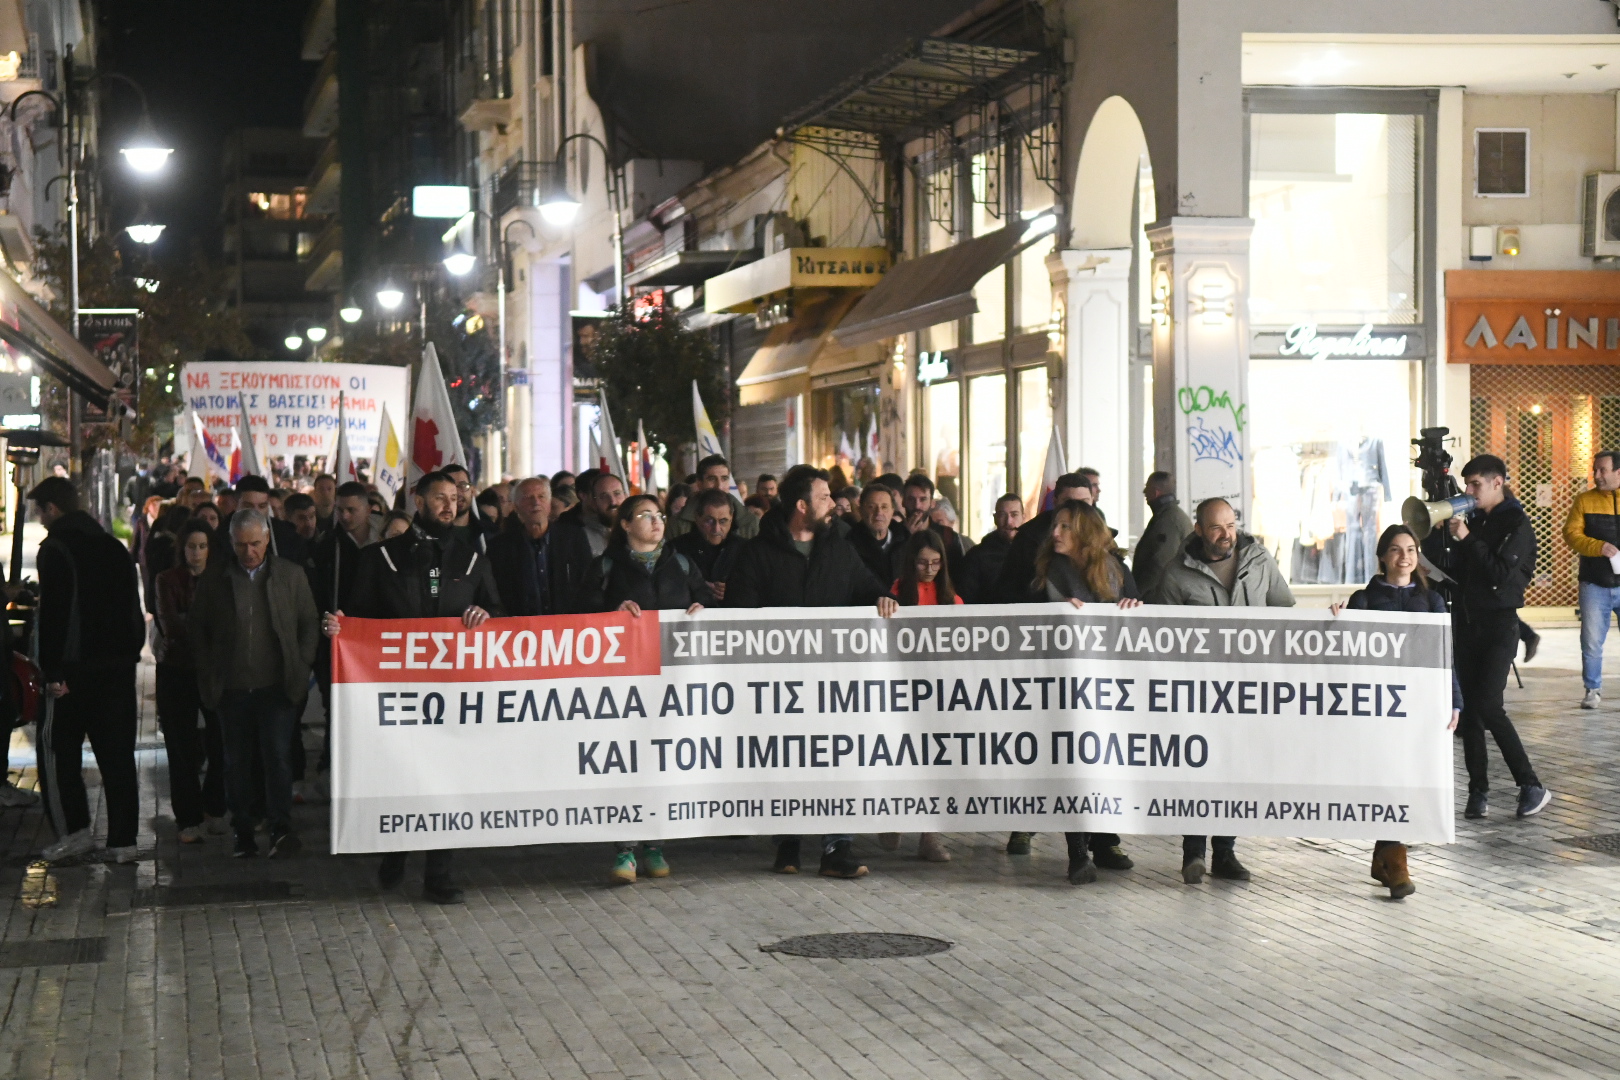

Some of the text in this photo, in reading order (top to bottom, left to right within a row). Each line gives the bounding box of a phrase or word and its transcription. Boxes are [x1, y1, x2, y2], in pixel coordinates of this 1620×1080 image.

[187, 371, 366, 390] ΝΑ ΞΕΚΟΥΜΠΙΣΤΟΥΝ ΟΙ
[190, 393, 259, 410] ΝΑΤΟΙΚΣ
[269, 394, 326, 409] ΒΑΣΕΙΣ!
[275, 415, 300, 428] ΣΤΗ
[287, 433, 323, 448] ΙΡΑΝ!
[378, 625, 627, 670] ΞΕΣΗΚΩΜΟΣ
[672, 624, 1408, 659] ΣΠΕΡΝΟΥΝ ΤΟΝ ΟΛΕΘΡΟ ΣΤΟΥΣ ΛΑΟΥΣ ΤΟΥ ΚΟΣΜΟΥ
[377, 676, 1407, 726] ΕΞΩ Η ΕΛΛΑΔΑ ΑΠΟ ΤΙΣ ΙΜΠΕΡΙΑΛΙΣΤΙΚΕΣ ΕΠΙΧΕΙΡΗΣΕΙΣ
[578, 730, 1209, 775] ΚΑΙ ΤΟΝ ΙΜΠΕΡΙΑΛΙΣΤΙΚΟ ΠΟΛΕΜΟ
[379, 811, 474, 834] ΕΡΓΑΤΙΚΟ
[480, 807, 559, 830] ΚΕΝΤΡΟ
[565, 804, 643, 826] ΠΑΤΡΑΣ
[668, 799, 764, 821] ΕΠΙΤΡΟΠΗ
[770, 798, 857, 817] ΕΙΡΗΝΗΣ
[862, 796, 941, 816] ΠΑΤΡΑΣ
[946, 796, 959, 815] &
[964, 796, 1047, 815] ΔΥΤΙΚΗΣ
[1052, 792, 1122, 815] ΑΧΑΪΑΣ
[1147, 798, 1258, 819] ΔΗΜΟΤΙΚΗ
[1264, 801, 1321, 821] ΑΡΧΗ
[1327, 802, 1410, 823] ΠΑΤΡΑΣ
